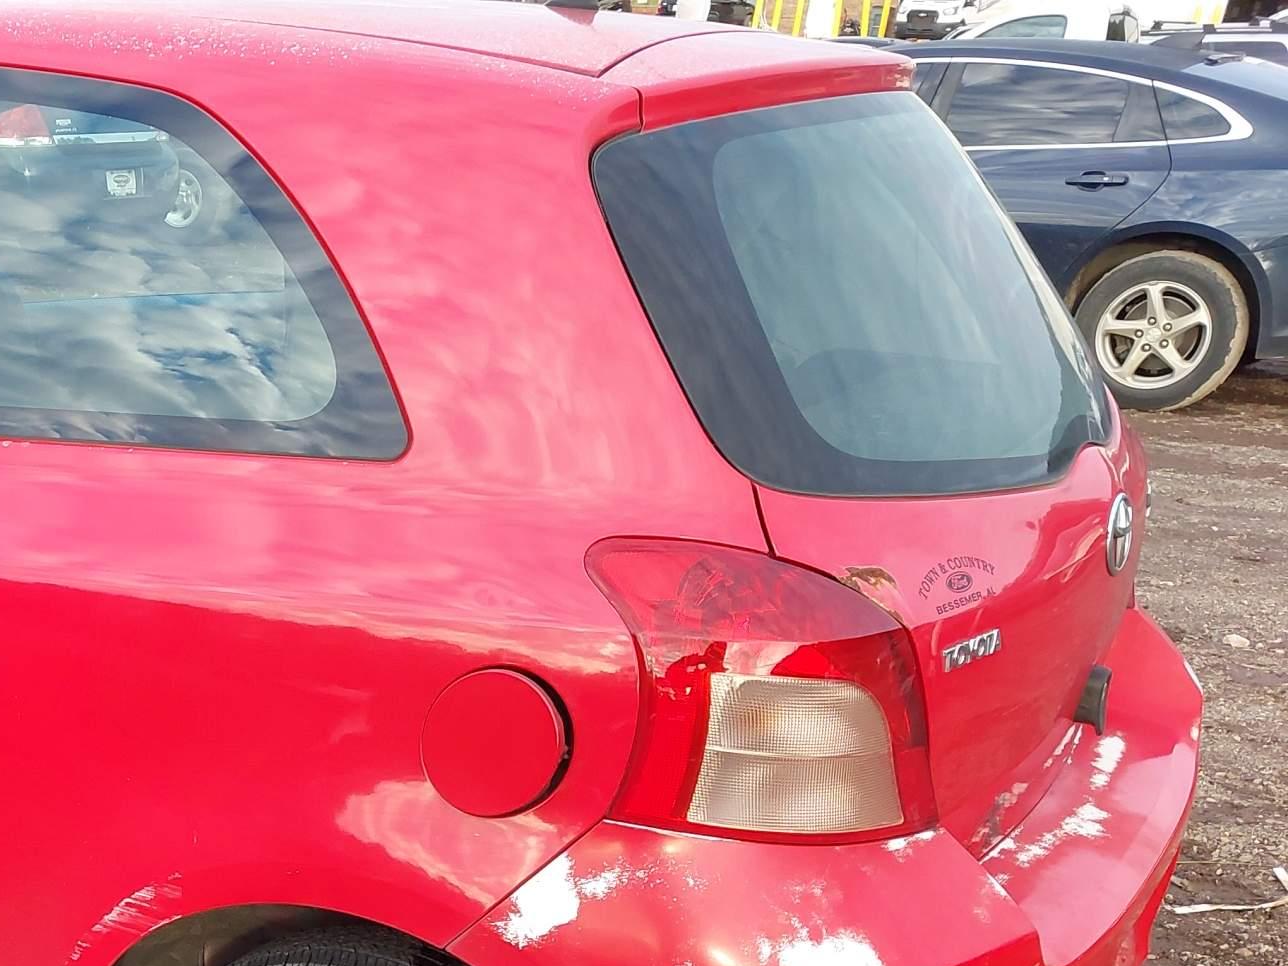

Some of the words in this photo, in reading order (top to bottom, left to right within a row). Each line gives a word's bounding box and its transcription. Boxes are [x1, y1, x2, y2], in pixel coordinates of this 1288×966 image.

[918, 567, 940, 600] TOWN
[938, 563, 948, 574] &
[947, 556, 995, 575] COUNTRY
[987, 586, 996, 597] AL
[943, 629, 1000, 672] TOYOTA
